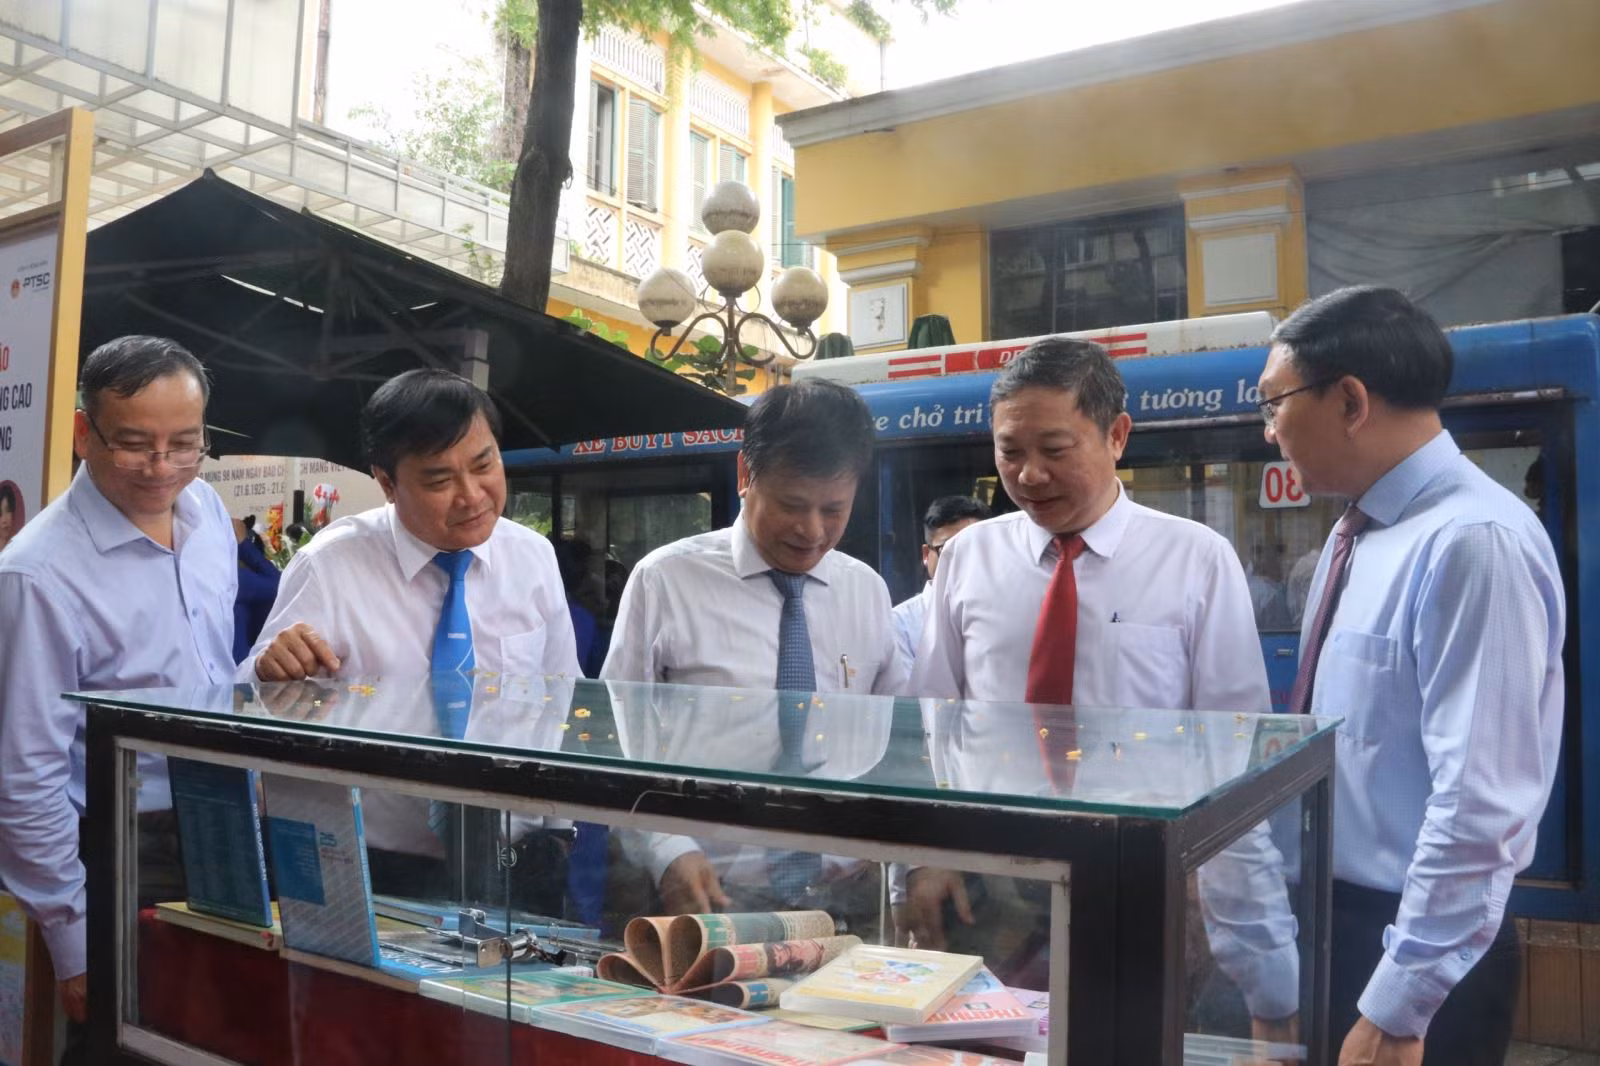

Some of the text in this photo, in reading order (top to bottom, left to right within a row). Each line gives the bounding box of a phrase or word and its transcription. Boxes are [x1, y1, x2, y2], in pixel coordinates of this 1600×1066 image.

[23, 272, 50, 288] PTSC
[12, 382, 32, 410] CAO
[899, 403, 945, 429] chở
[1140, 388, 1224, 412] tương
